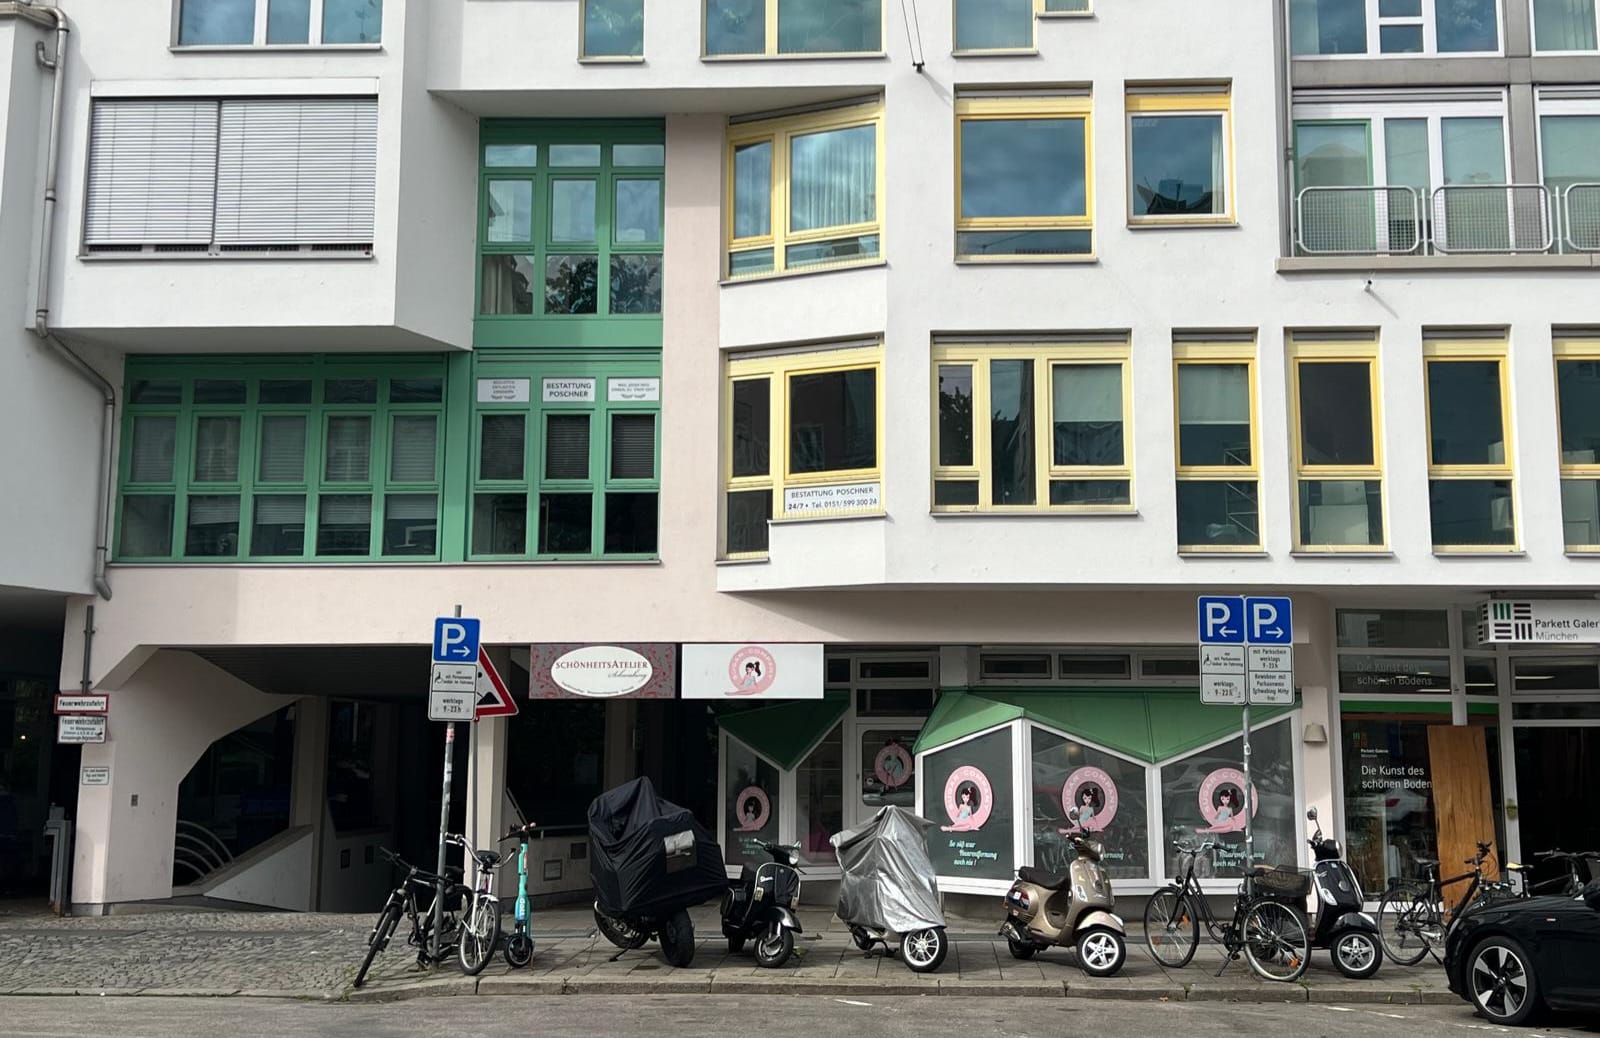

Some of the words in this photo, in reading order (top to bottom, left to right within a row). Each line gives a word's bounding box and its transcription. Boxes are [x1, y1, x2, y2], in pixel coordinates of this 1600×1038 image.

[791, 489, 833, 498] BESTATTUNG
[836, 487, 873, 496] POSCHNER
[1206, 602, 1230, 637] P
[1253, 603, 1278, 638] P
[1535, 619, 1570, 628] Parkett
[441, 623, 466, 656] P
[1535, 631, 1578, 640] München
[1361, 765, 1377, 775] Die
[1379, 765, 1405, 775] Kunst
[1407, 765, 1425, 775] des
[1361, 778, 1401, 789] schönen
